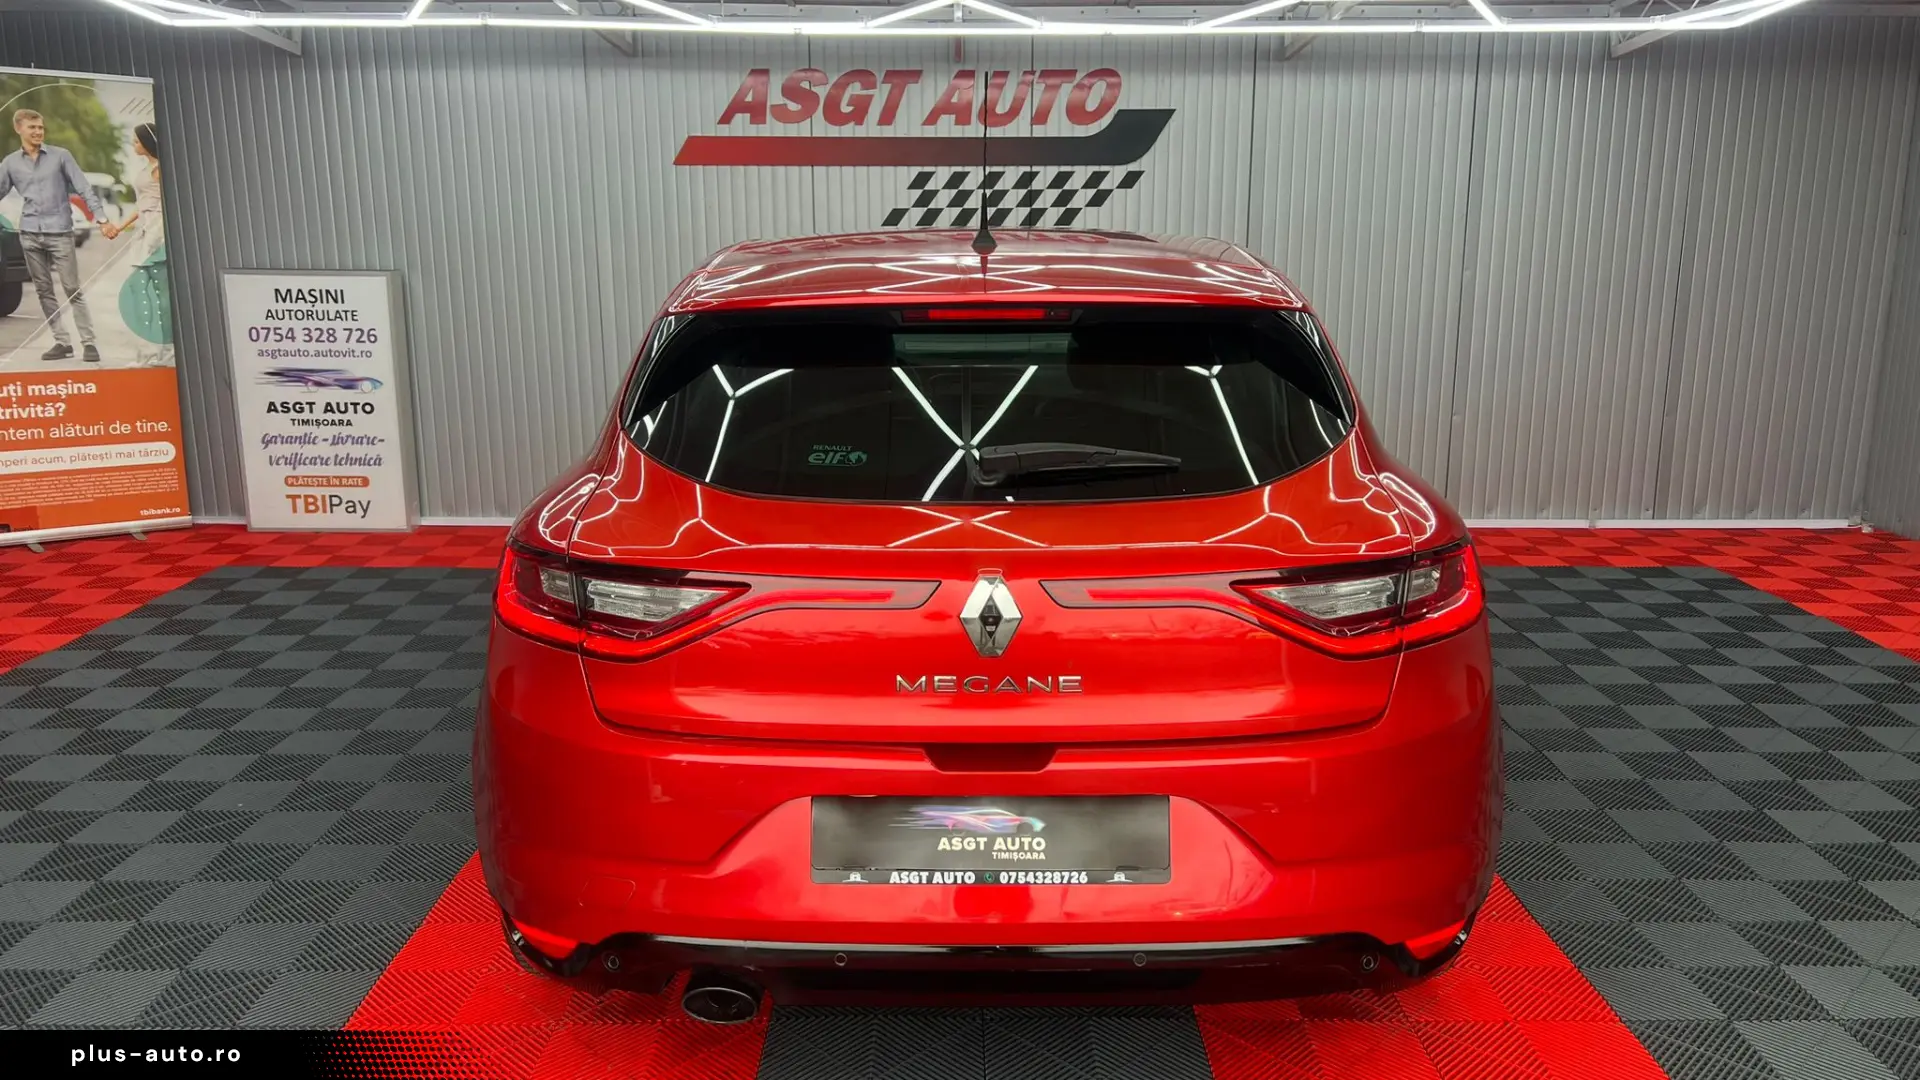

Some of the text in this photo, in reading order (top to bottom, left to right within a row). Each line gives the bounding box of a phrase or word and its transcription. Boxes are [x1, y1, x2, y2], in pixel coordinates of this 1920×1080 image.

[717, 68, 1122, 128] ASGT AUTO
[274, 288, 346, 308] MAȘINI
[265, 309, 359, 322] AUTORULATE
[248, 326, 378, 344] 0754 328 726
[257, 348, 373, 360] asgtauto.autovit.ro
[266, 401, 375, 415] ASGT AUTO
[49, 421, 104, 438] alături
[109, 420, 131, 435] de
[136, 419, 171, 434] tine.
[31, 454, 67, 465] acum,
[115, 449, 135, 459] mai
[342, 478, 363, 486] RATE
[140, 507, 181, 516] tbibank.ro
[285, 494, 371, 519] TBIPay
[895, 674, 1083, 693] MEGANE
[937, 837, 1046, 851] ASGT AUTO
[889, 871, 1088, 885] ASGT AUTO 0754328726
